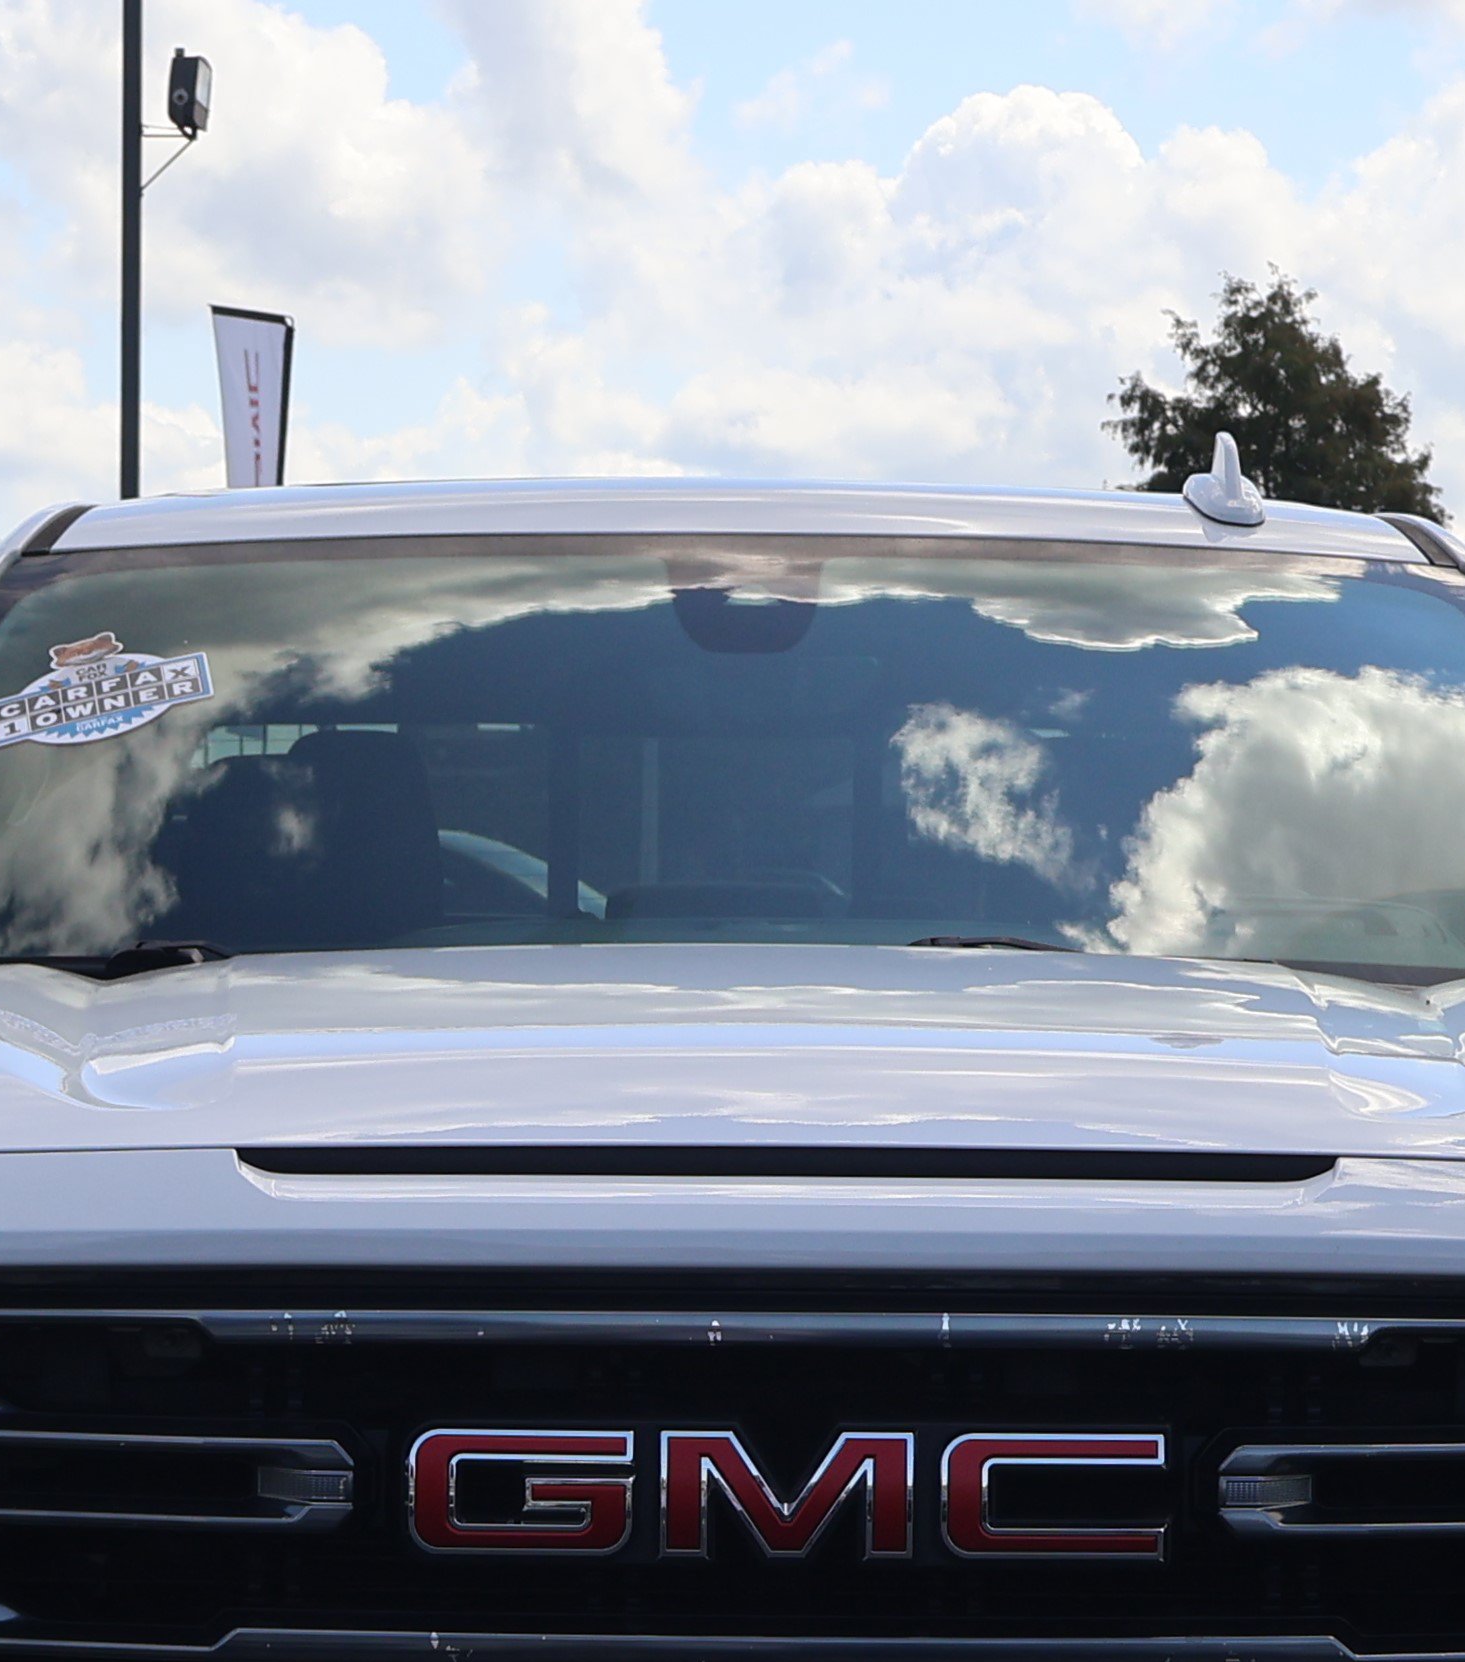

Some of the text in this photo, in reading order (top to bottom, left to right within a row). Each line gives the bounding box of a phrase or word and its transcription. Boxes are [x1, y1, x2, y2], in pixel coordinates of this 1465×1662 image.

[0, 665, 190, 718] CARFAX
[36, 682, 194, 727] OWNER
[407, 1429, 1167, 1561] GMC
